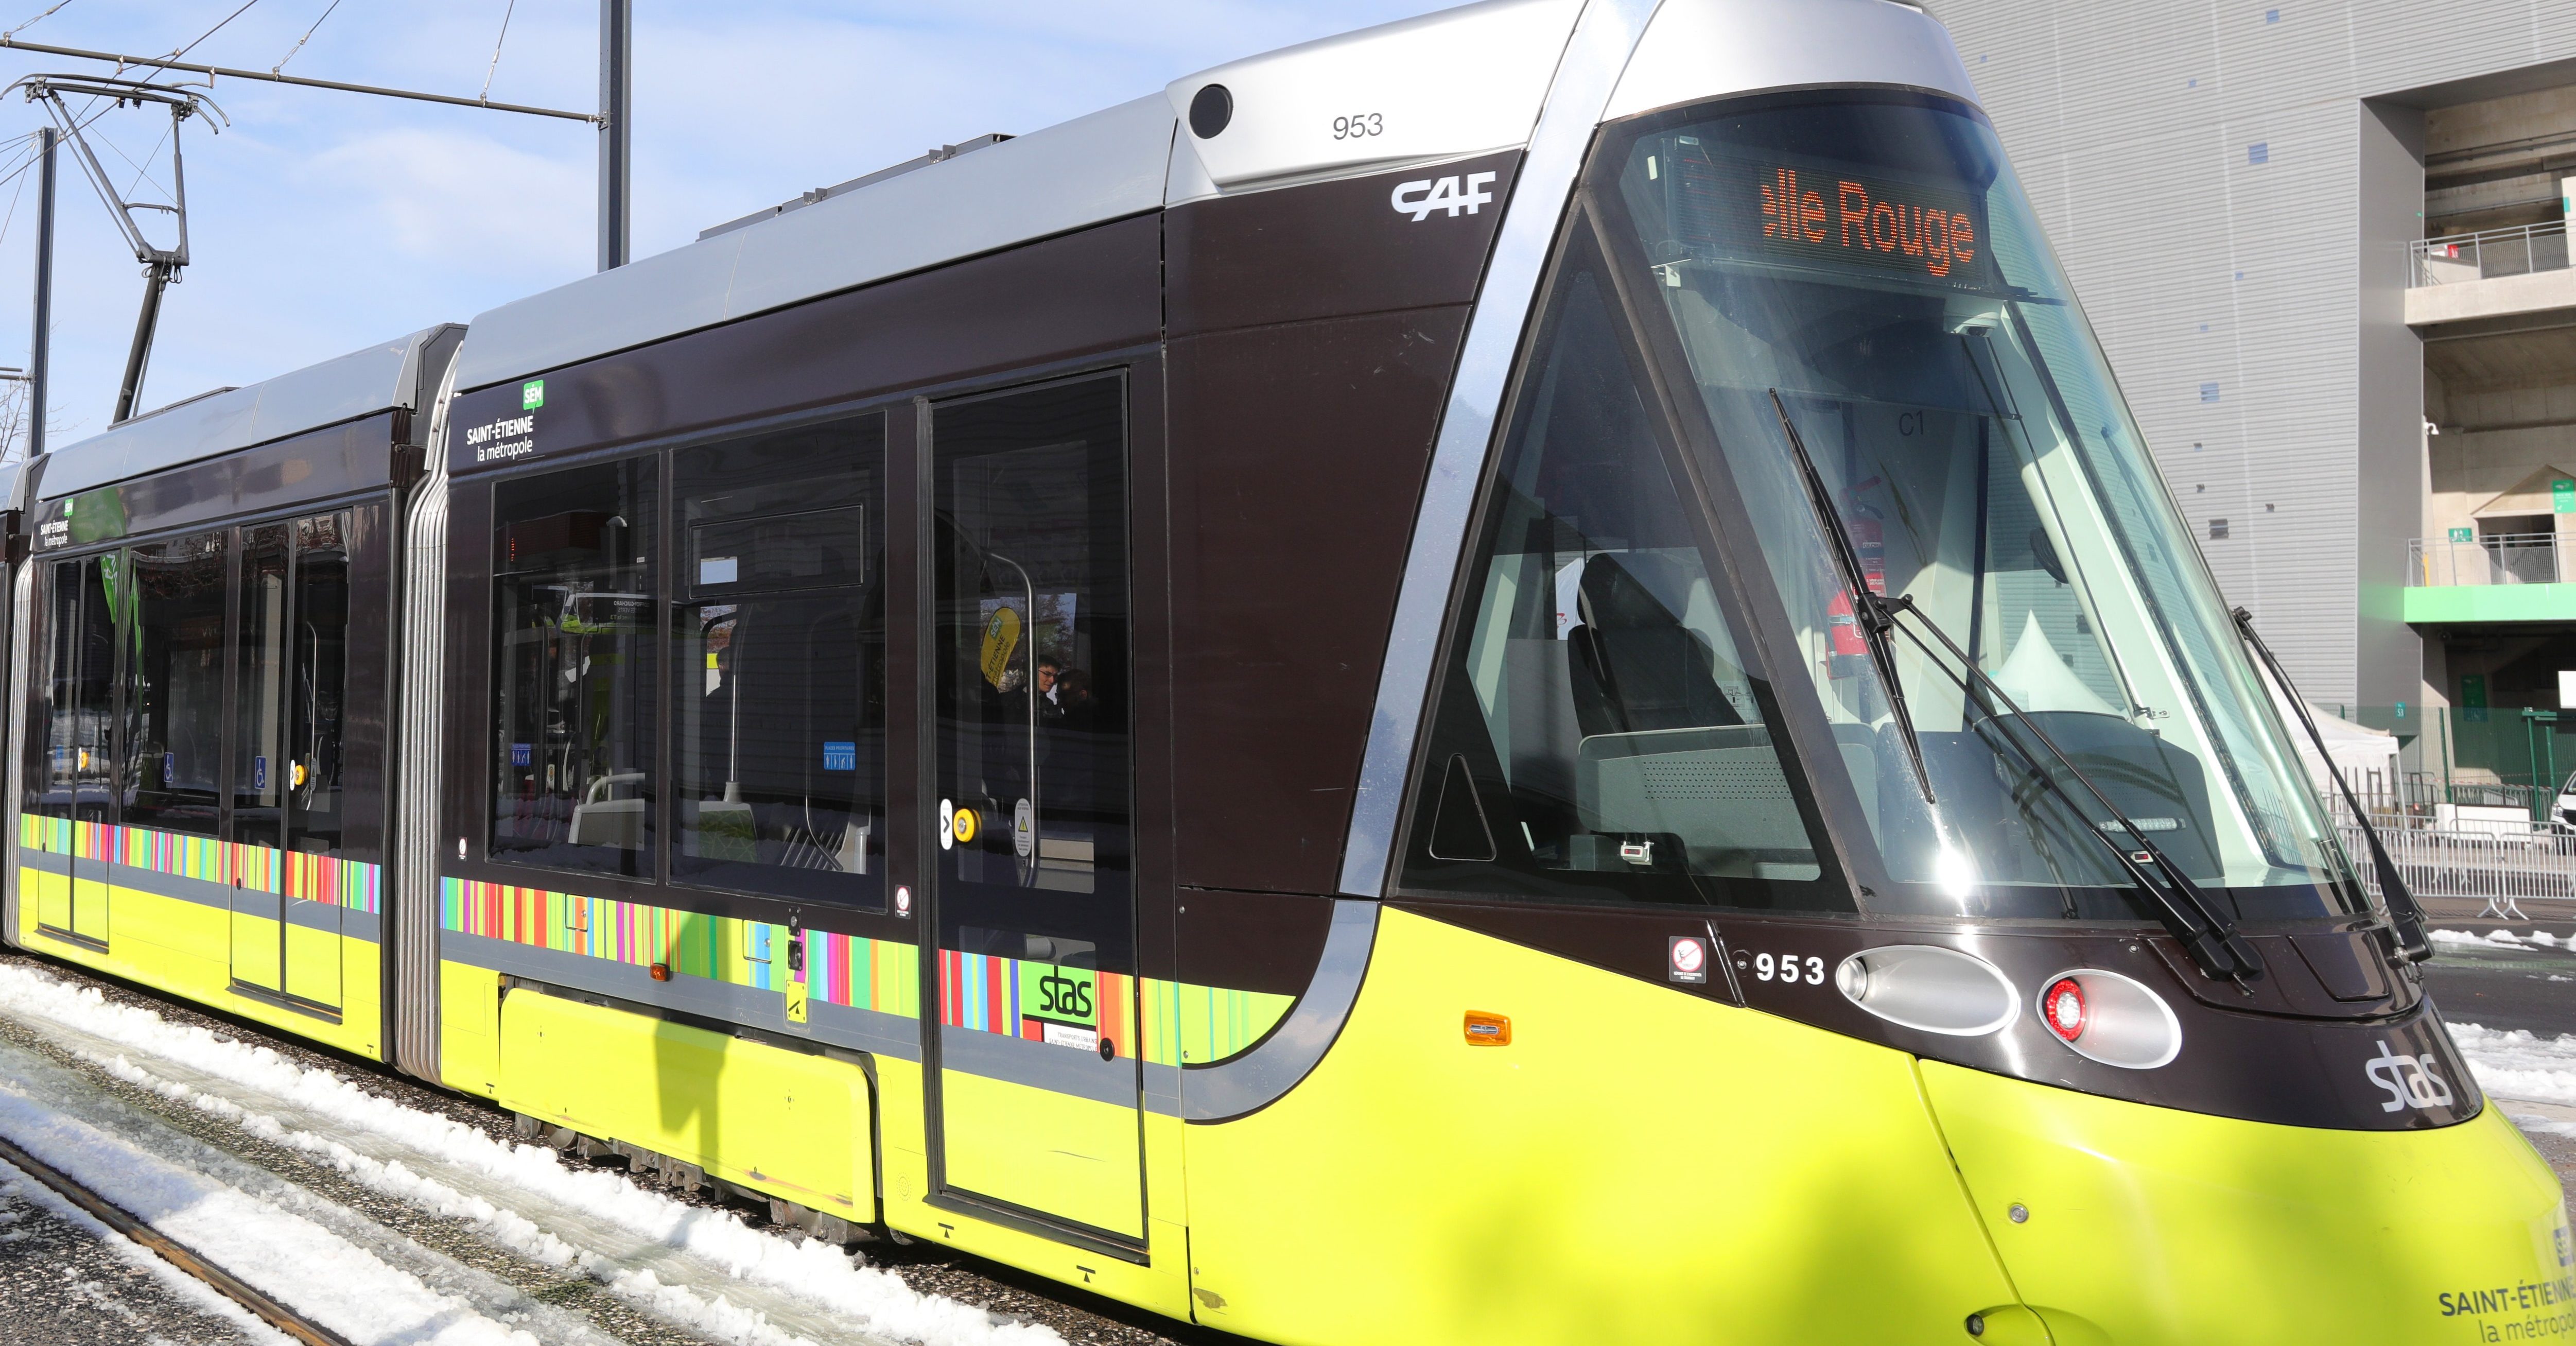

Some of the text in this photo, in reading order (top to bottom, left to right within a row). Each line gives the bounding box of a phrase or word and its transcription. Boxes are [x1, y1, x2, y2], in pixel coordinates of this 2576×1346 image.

[1333, 112, 1383, 140] 953
[1391, 171, 1496, 222] CAF
[1838, 181, 1975, 277] Rouge
[524, 384, 542, 404] SÉM
[467, 415, 533, 445] SAINT-ÉTIENNE
[1899, 410, 1924, 437] C1
[477, 436, 533, 462] la métropole
[41, 520, 68, 536] SAINT-ÉTIENNE
[44, 532, 67, 547] la métropole
[1756, 953, 1825, 985] 953
[1040, 965, 1092, 1017] stas
[2365, 1040, 2453, 1112] stas
[2478, 1319, 2501, 1344] la
